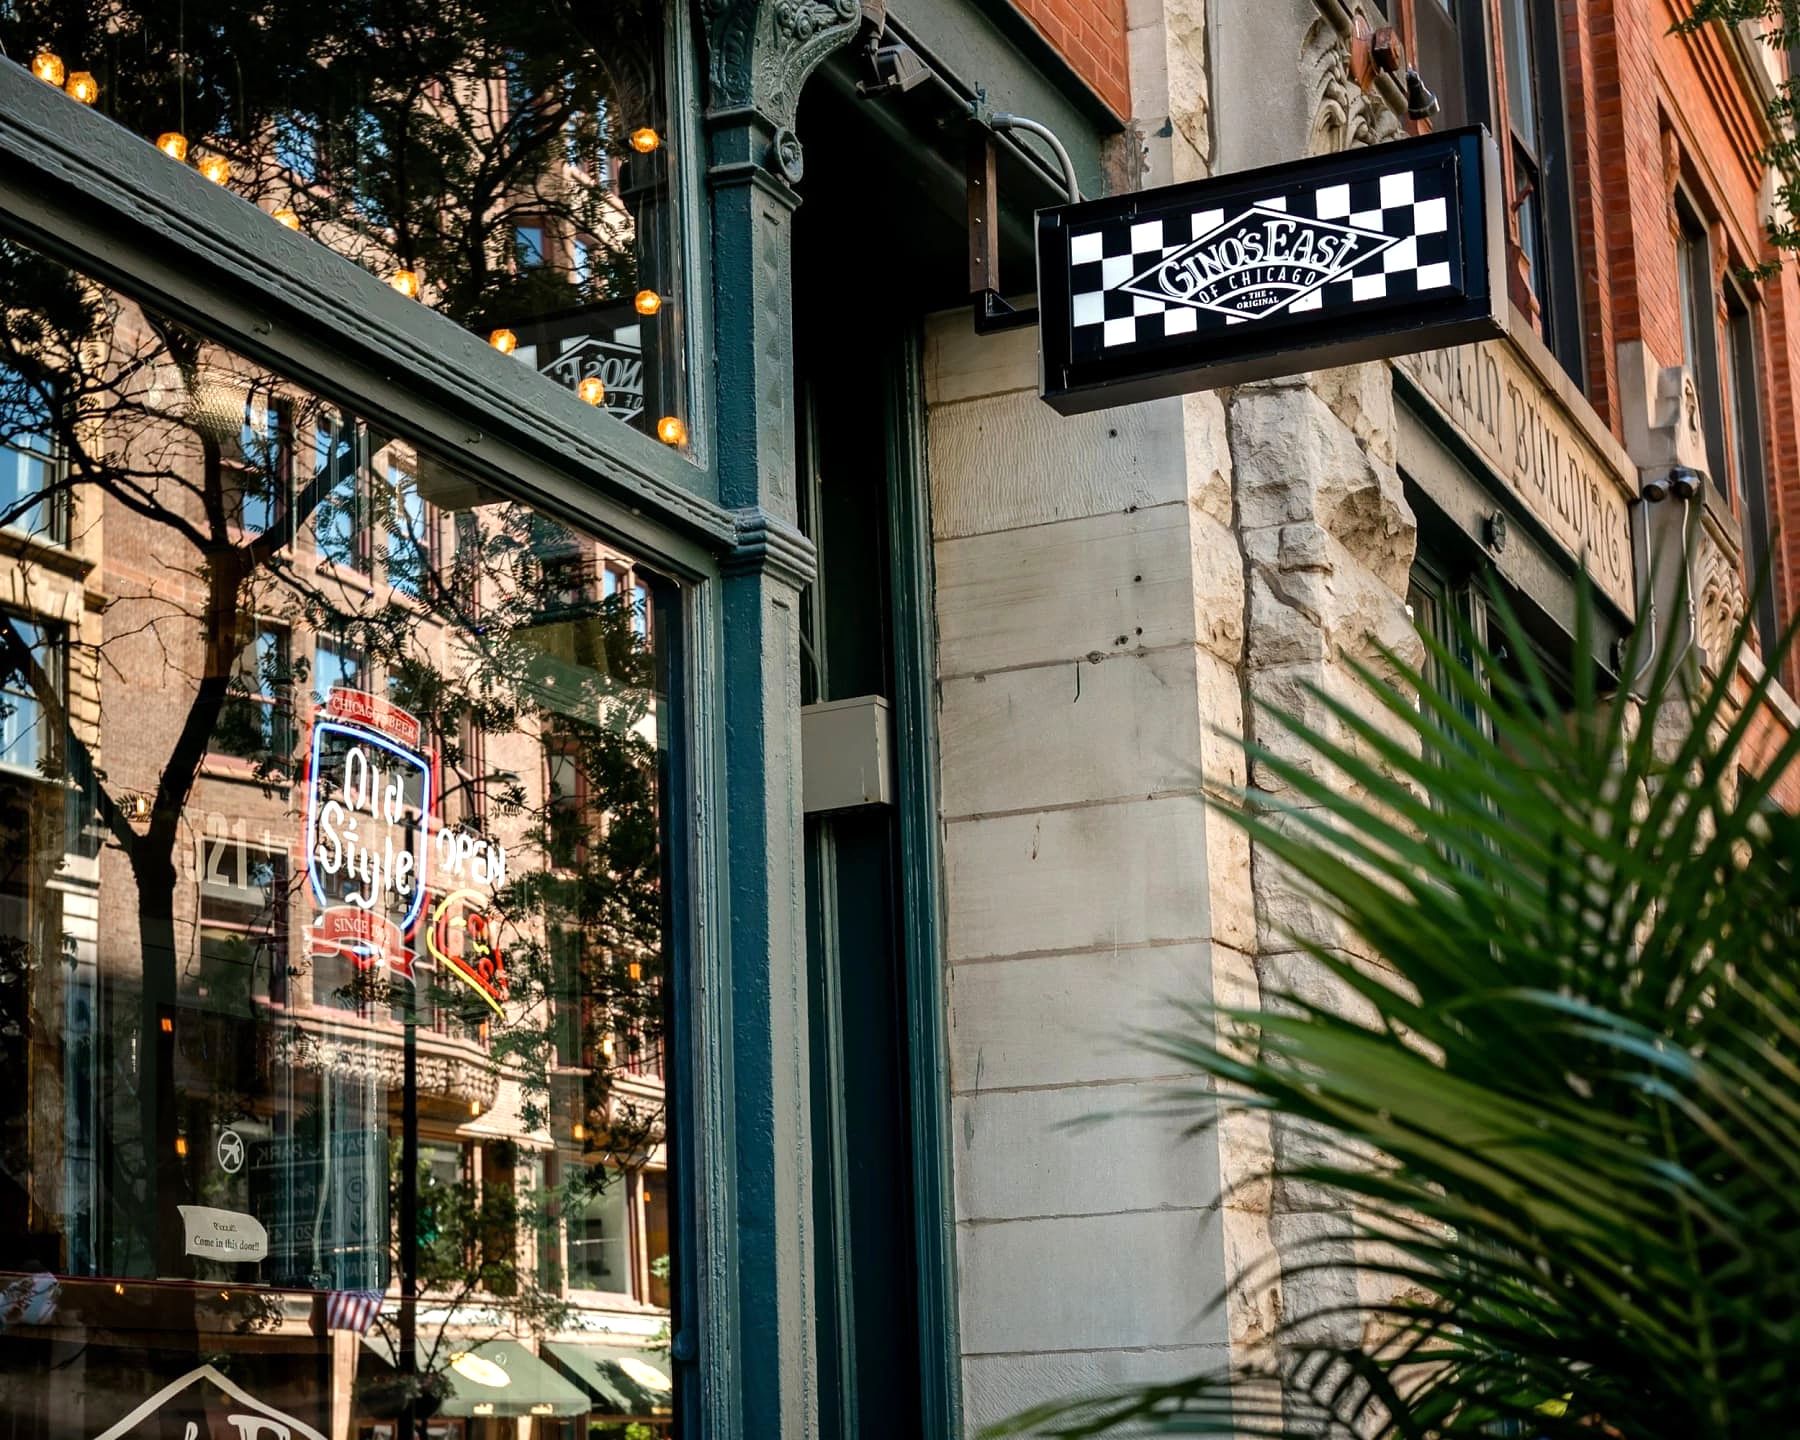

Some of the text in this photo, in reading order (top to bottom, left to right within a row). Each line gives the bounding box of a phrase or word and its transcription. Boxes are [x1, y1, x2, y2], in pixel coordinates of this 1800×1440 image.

[1158, 228, 1264, 299] GINO'S
[1198, 266, 1316, 304] OF CHICAGO
[1248, 290, 1267, 299] THE
[1236, 295, 1280, 310] ORIGINAL
[388, 714, 416, 740] BEER
[343, 747, 404, 826] Old
[319, 800, 413, 909] Style
[435, 827, 506, 888] OPEN
[334, 918, 369, 934] SINCE
[193, 1235, 214, 1248] Come
[215, 1238, 223, 1249] in
[224, 1239, 238, 1250] this
